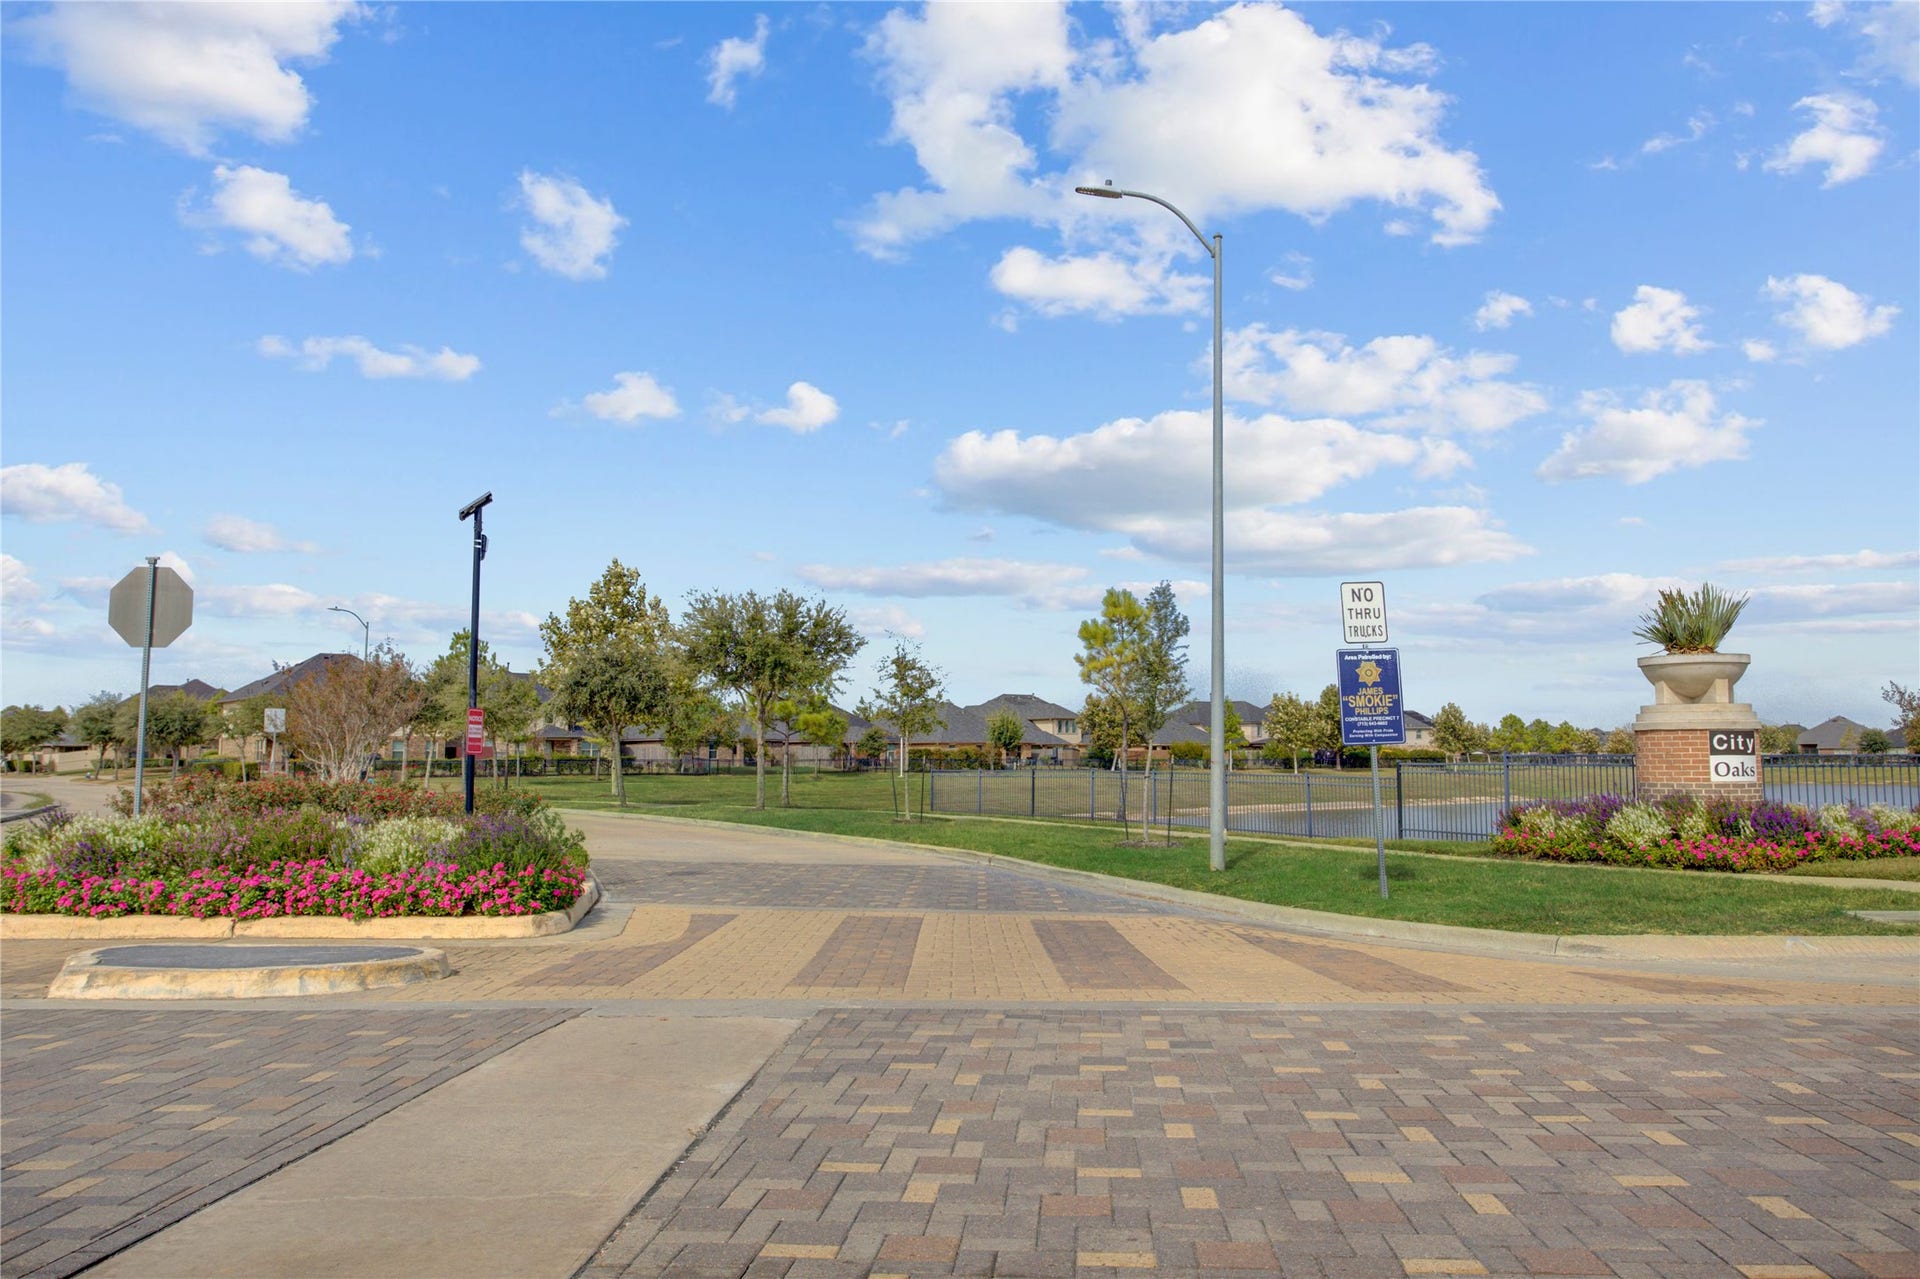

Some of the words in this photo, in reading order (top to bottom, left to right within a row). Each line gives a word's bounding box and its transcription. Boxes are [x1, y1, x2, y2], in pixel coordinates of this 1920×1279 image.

[1351, 587, 1374, 602] NO
[1347, 607, 1381, 620] THRU
[1348, 624, 1383, 637] TRUCKS
[1357, 687, 1384, 695] JAMES
[1355, 707, 1389, 715] PHILLIPS
[1712, 733, 1754, 753] City
[1714, 761, 1755, 777] Oaks
